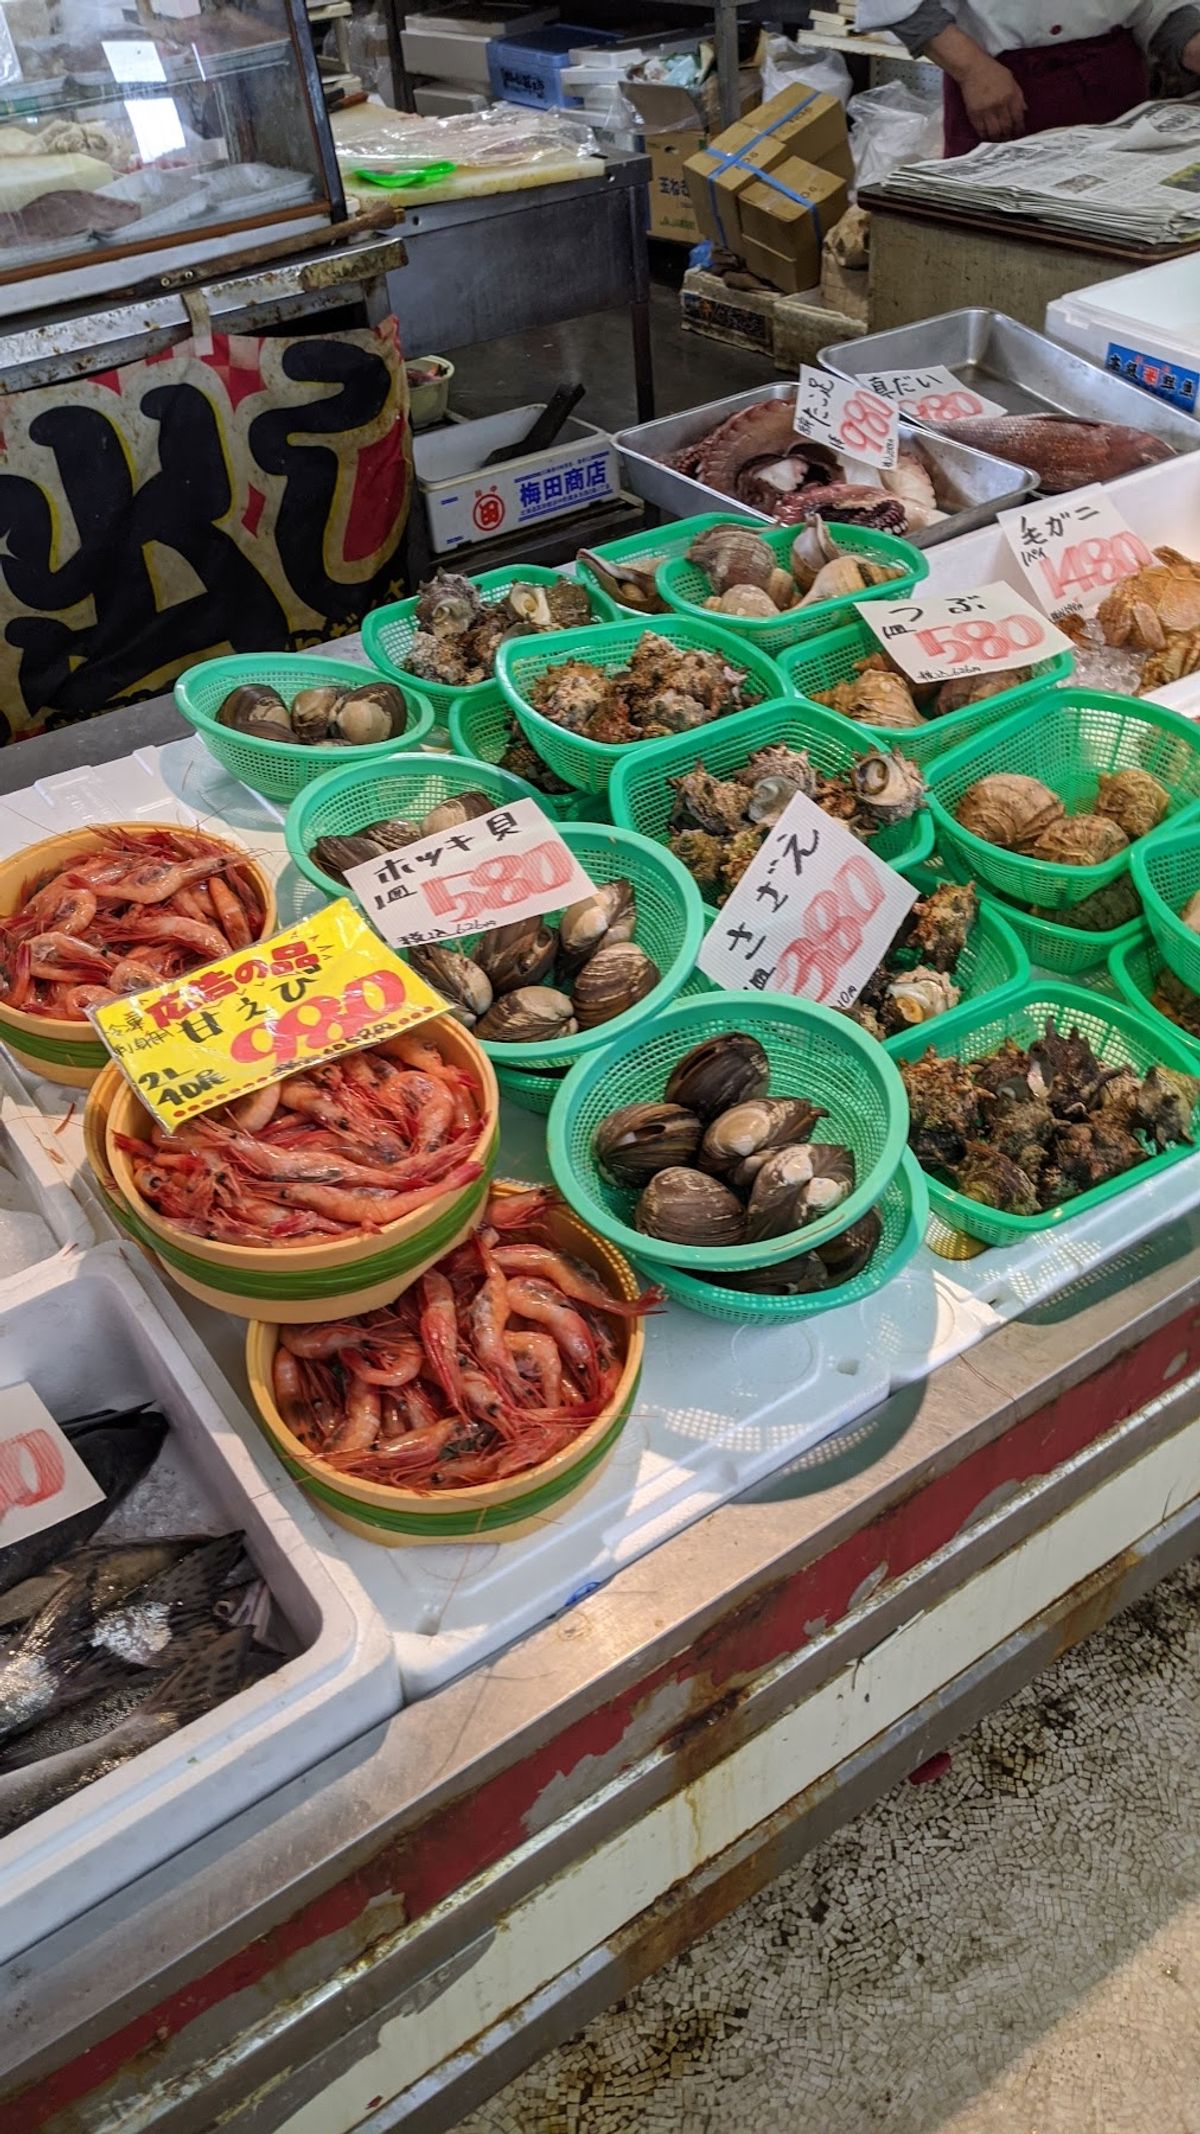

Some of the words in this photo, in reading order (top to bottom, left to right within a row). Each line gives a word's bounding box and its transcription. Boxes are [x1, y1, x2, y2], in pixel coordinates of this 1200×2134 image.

[840, 390, 894, 453] 980
[519, 460, 607, 508] 梅田商店
[1020, 506, 1100, 546] 毛ガニ
[1039, 531, 1153, 600] 1480
[888, 595, 987, 622] つぶ
[914, 614, 1045, 664] 580
[373, 812, 523, 884] ホッキ貝
[420, 840, 575, 922] 580
[374, 884, 418, 910] 1皿
[726, 828, 820, 961] さざえ
[775, 854, 886, 1003] 380
[144, 941, 320, 1030] 広告の品
[178, 964, 322, 1044] 甘えび
[743, 966, 777, 991] 皿
[230, 969, 407, 1066] 980
